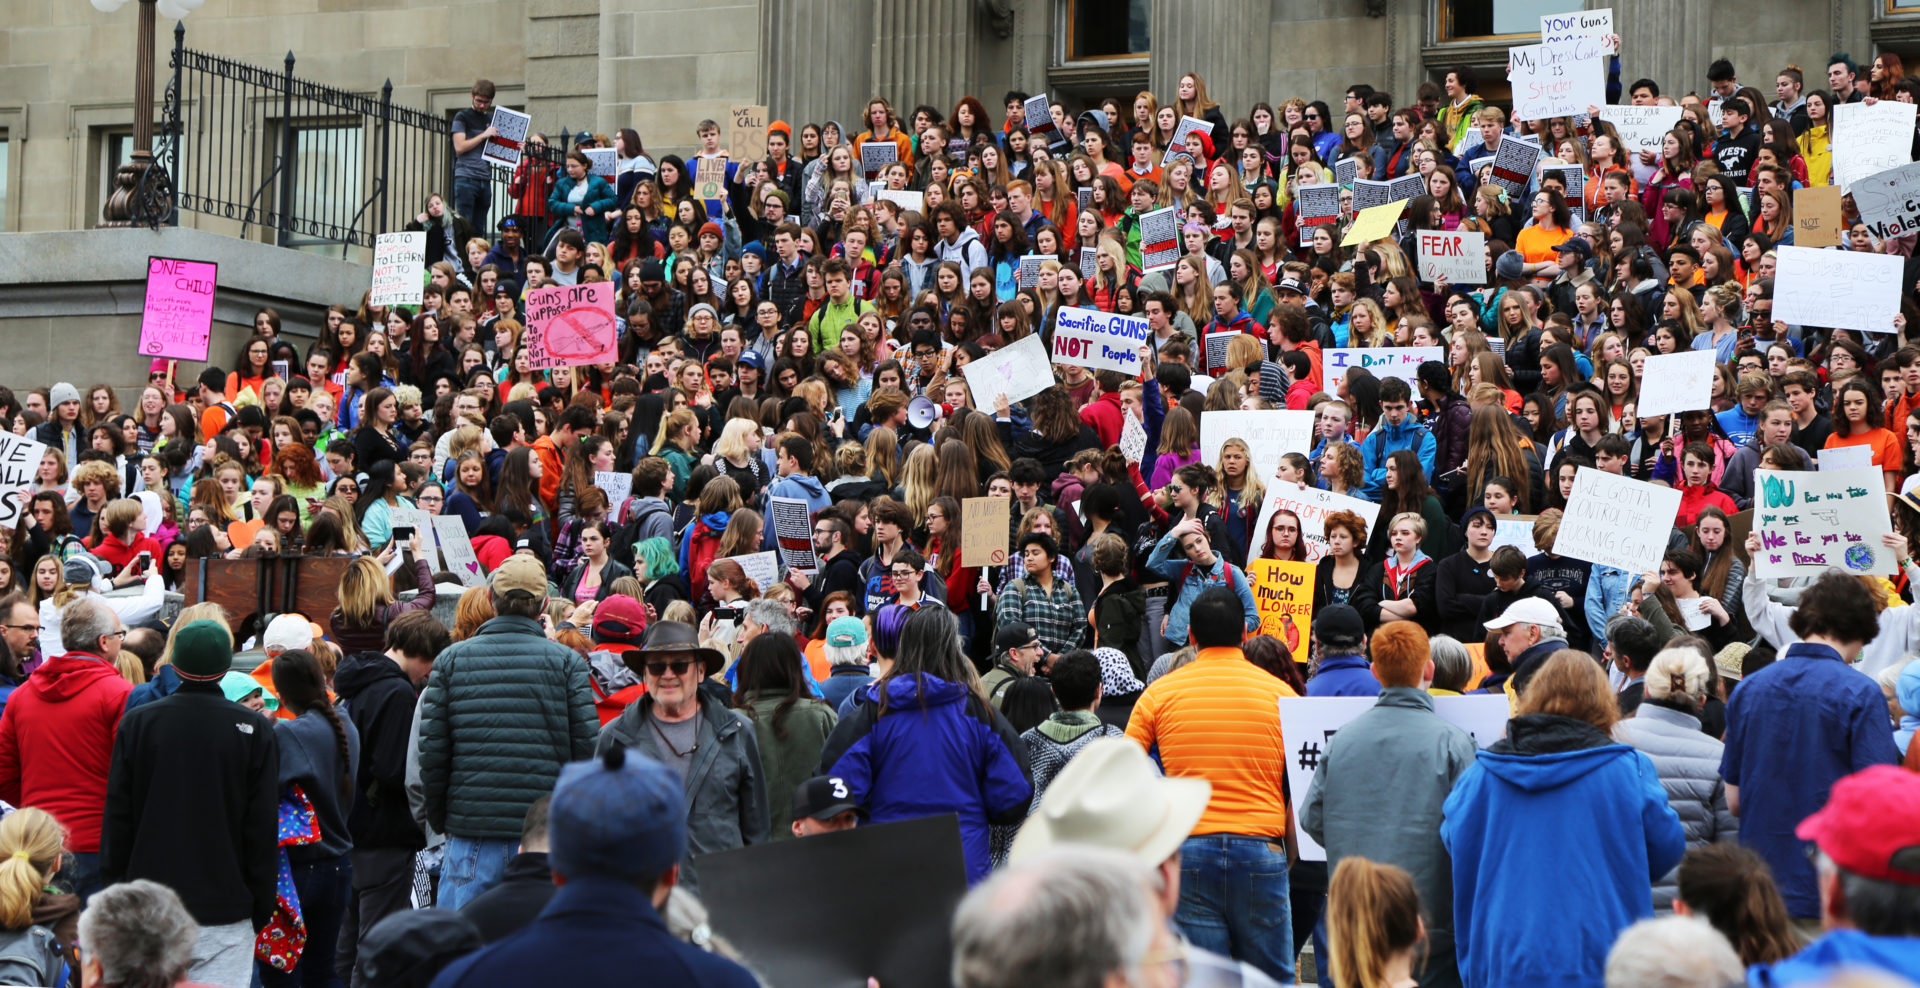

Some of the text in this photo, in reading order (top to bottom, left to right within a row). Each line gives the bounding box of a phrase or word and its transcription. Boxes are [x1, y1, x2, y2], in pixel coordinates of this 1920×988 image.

[1580, 15, 1608, 29] Guns
[1512, 51, 1536, 75] My
[1540, 47, 1574, 67] Dress
[1574, 41, 1600, 61] Code
[1528, 80, 1574, 100] Stricter
[733, 109, 749, 117] WE
[1522, 102, 1576, 118] Gun Laws
[1602, 107, 1660, 118] PROTECT YOUR
[736, 117, 763, 128] CALL
[1623, 117, 1648, 126] KIDS
[733, 130, 765, 161] BS
[1718, 146, 1748, 161] WEST
[699, 158, 726, 172] LIVES
[1800, 217, 1820, 226] NOT
[377, 233, 413, 245] I GO TO
[1422, 235, 1464, 257] FEAR
[149, 258, 187, 276] ONE
[376, 252, 424, 265] TO LEARN
[374, 265, 410, 277] NOT TO
[175, 277, 214, 296] CHILD
[373, 293, 421, 304] PRACTICE
[528, 286, 598, 306] Guns are
[1058, 312, 1148, 341] Sacrifice GUNS
[527, 333, 543, 343] help
[528, 342, 538, 350] us
[1054, 335, 1094, 360] NOT
[1102, 344, 1137, 365] People
[555, 358, 567, 367] us
[1332, 352, 1350, 367] I
[1580, 473, 1651, 508] WE GOTTA
[1760, 474, 1795, 508] YOU
[1804, 491, 1821, 503] Fear
[1846, 486, 1869, 499] take
[968, 500, 1005, 519] NO MORE
[1303, 503, 1317, 520] OF
[1567, 495, 1655, 533] CONTROL THESE
[1761, 514, 1777, 527] your
[985, 530, 1005, 547] GUN
[1562, 521, 1659, 562] FUCKING GUNS
[1761, 530, 1787, 551] We
[1794, 531, 1811, 546] Fear
[1843, 531, 1863, 542] take
[1267, 565, 1304, 586] How
[1257, 585, 1294, 601] much
[1261, 598, 1312, 616] LONGER
[828, 778, 848, 799] 3
